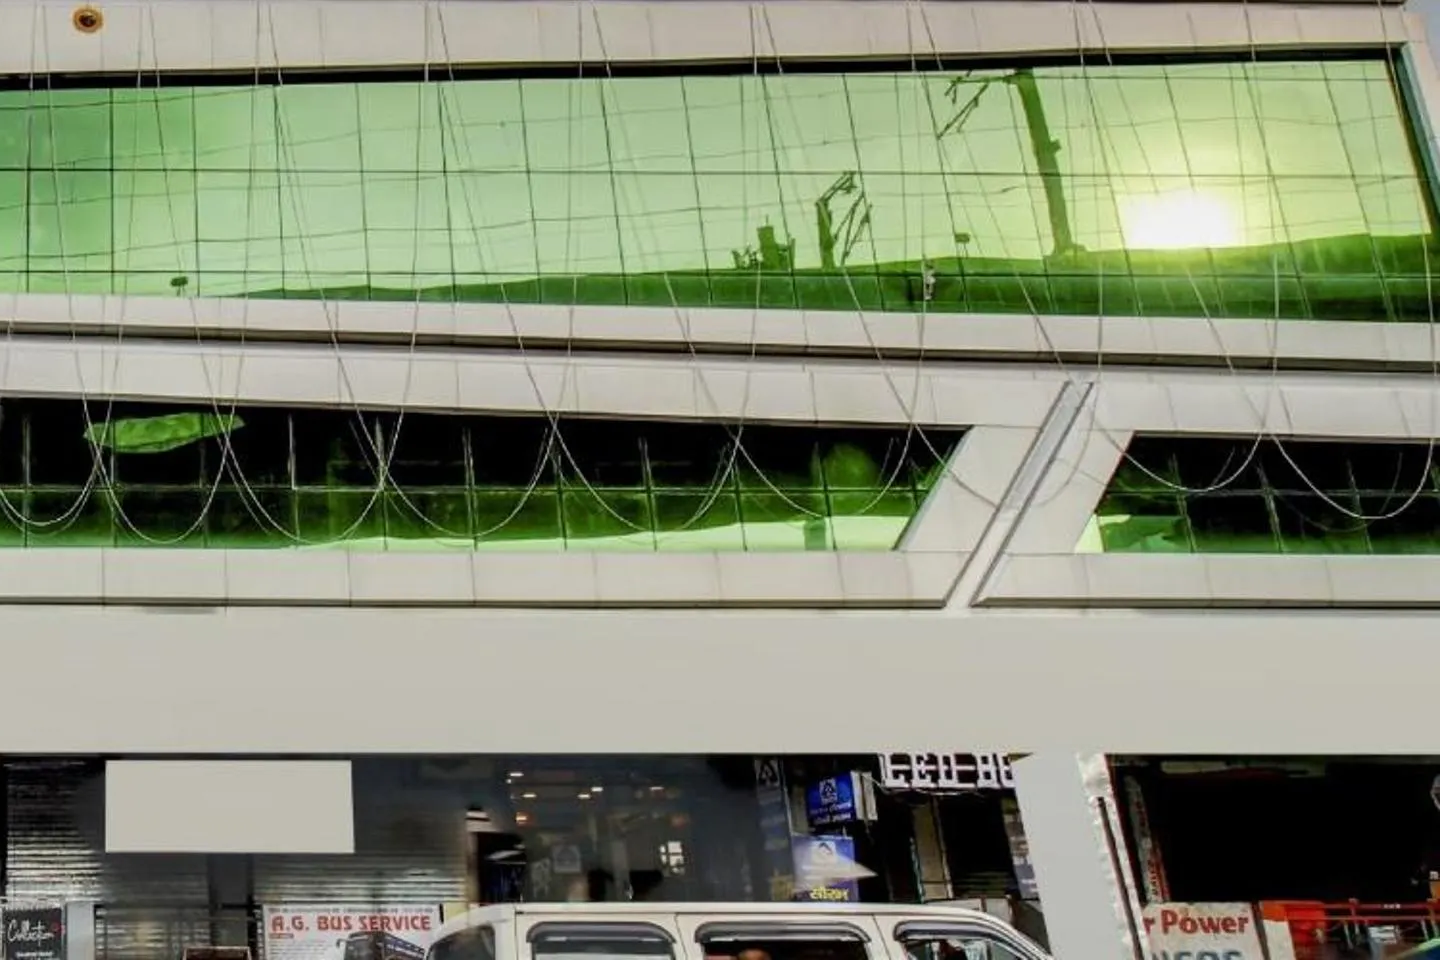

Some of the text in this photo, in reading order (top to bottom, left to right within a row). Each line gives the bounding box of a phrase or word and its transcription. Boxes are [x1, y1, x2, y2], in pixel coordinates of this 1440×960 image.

[271, 915, 432, 931] A.G. BUS SERVICE
[1161, 909, 1249, 935] Power
